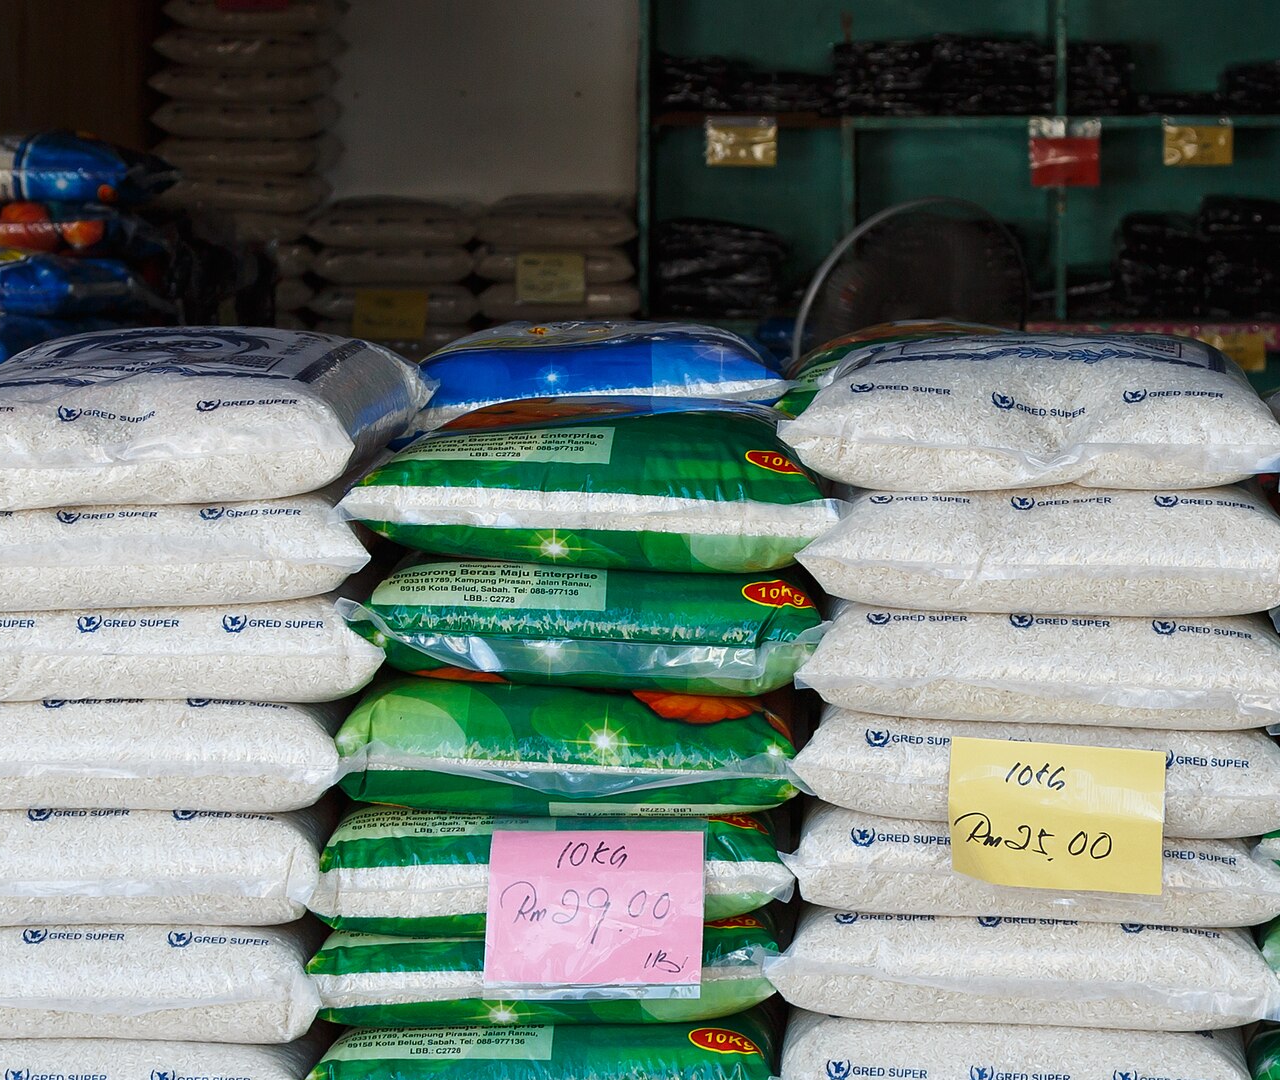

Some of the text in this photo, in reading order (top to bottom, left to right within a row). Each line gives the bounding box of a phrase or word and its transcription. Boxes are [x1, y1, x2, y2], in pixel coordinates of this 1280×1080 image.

[875, 384, 951, 397] GRED SUPER
[1148, 390, 1224, 400] GRED SUPER
[501, 569, 530, 578] Maju
[533, 570, 598, 580] Enterprise
[454, 577, 497, 585] Kampung
[499, 578, 534, 586] Pirasan,
[451, 585, 479, 593] Belud,
[530, 588, 579, 596] 088-977136
[756, 581, 806, 607] 10Kg
[463, 594, 515, 603] LBB.: C2728
[248, 618, 324, 629] GRED SUPER
[852, 1065, 928, 1080] GRED SUPER
